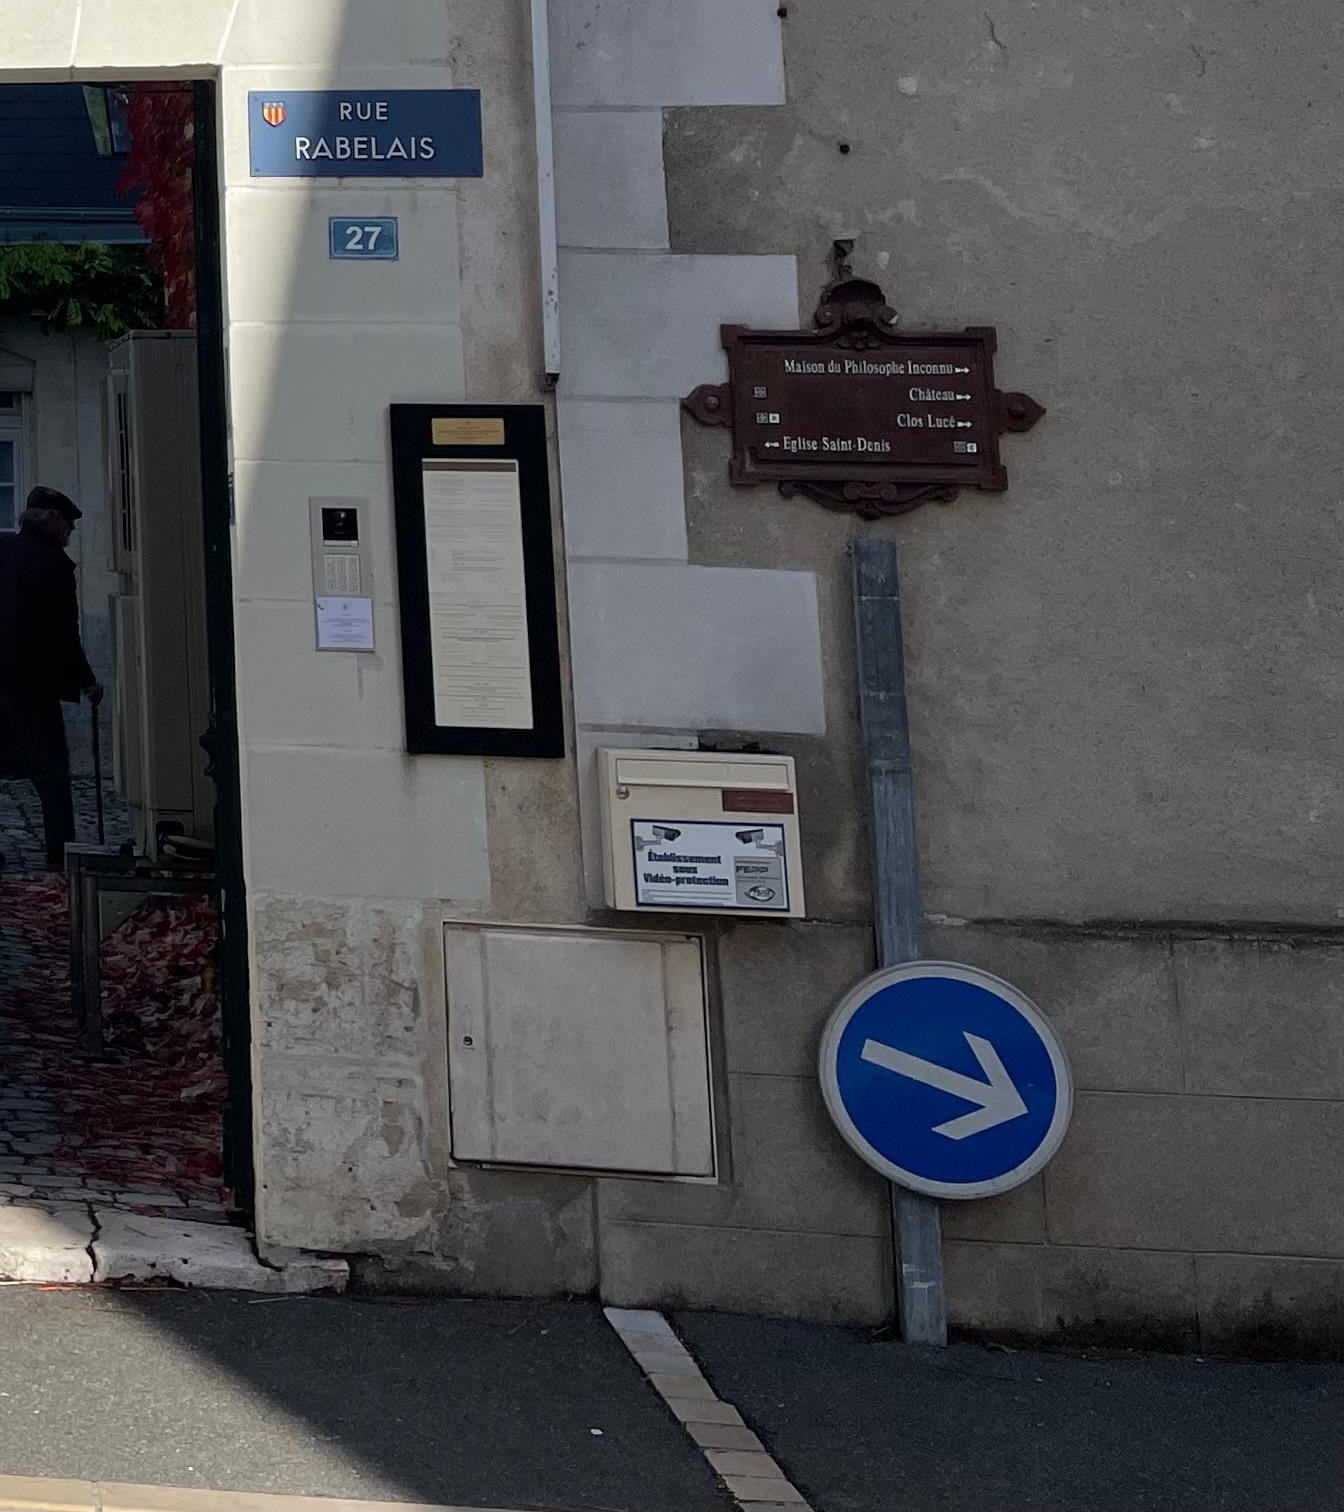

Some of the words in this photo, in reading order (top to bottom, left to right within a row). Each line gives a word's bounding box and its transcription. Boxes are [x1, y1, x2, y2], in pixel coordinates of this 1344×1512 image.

[339, 101, 389, 121] RUE
[295, 136, 436, 161] RABELAIS
[345, 225, 383, 251] 27
[784, 358, 824, 376] Maison
[827, 359, 842, 376] du
[844, 359, 906, 378] Philosophe
[908, 360, 954, 376] Inconnu
[908, 387, 956, 403] Château
[897, 413, 924, 429] Clos
[927, 414, 957, 430] Lucé
[783, 436, 818, 453] Eglise
[822, 437, 891, 453] Saint-Denis
[647, 849, 722, 865] Établissement
[642, 872, 730, 887] Vidéo-protection
